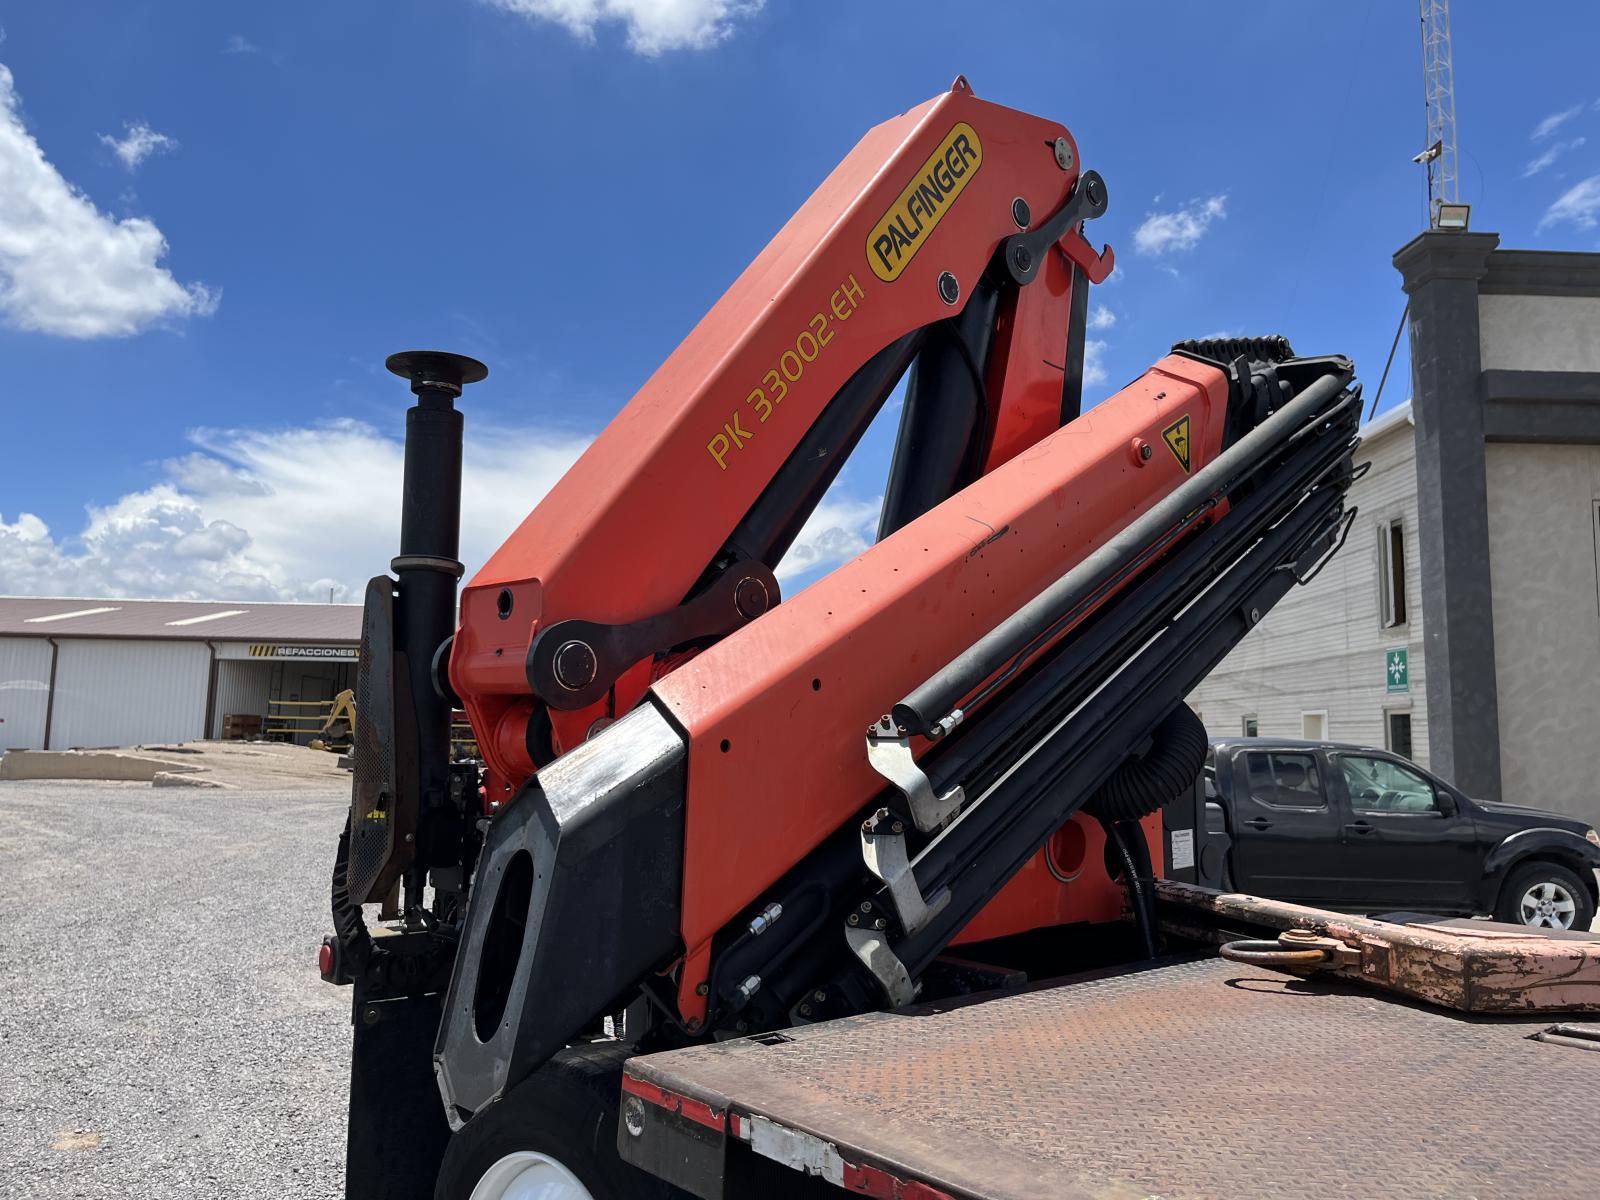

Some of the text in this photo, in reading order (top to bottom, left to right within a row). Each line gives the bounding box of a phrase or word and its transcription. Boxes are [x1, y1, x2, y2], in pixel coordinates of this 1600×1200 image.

[873, 134, 977, 272] PALFINGER
[706, 410, 755, 471] PK
[278, 647, 355, 657] REFACCIONES
